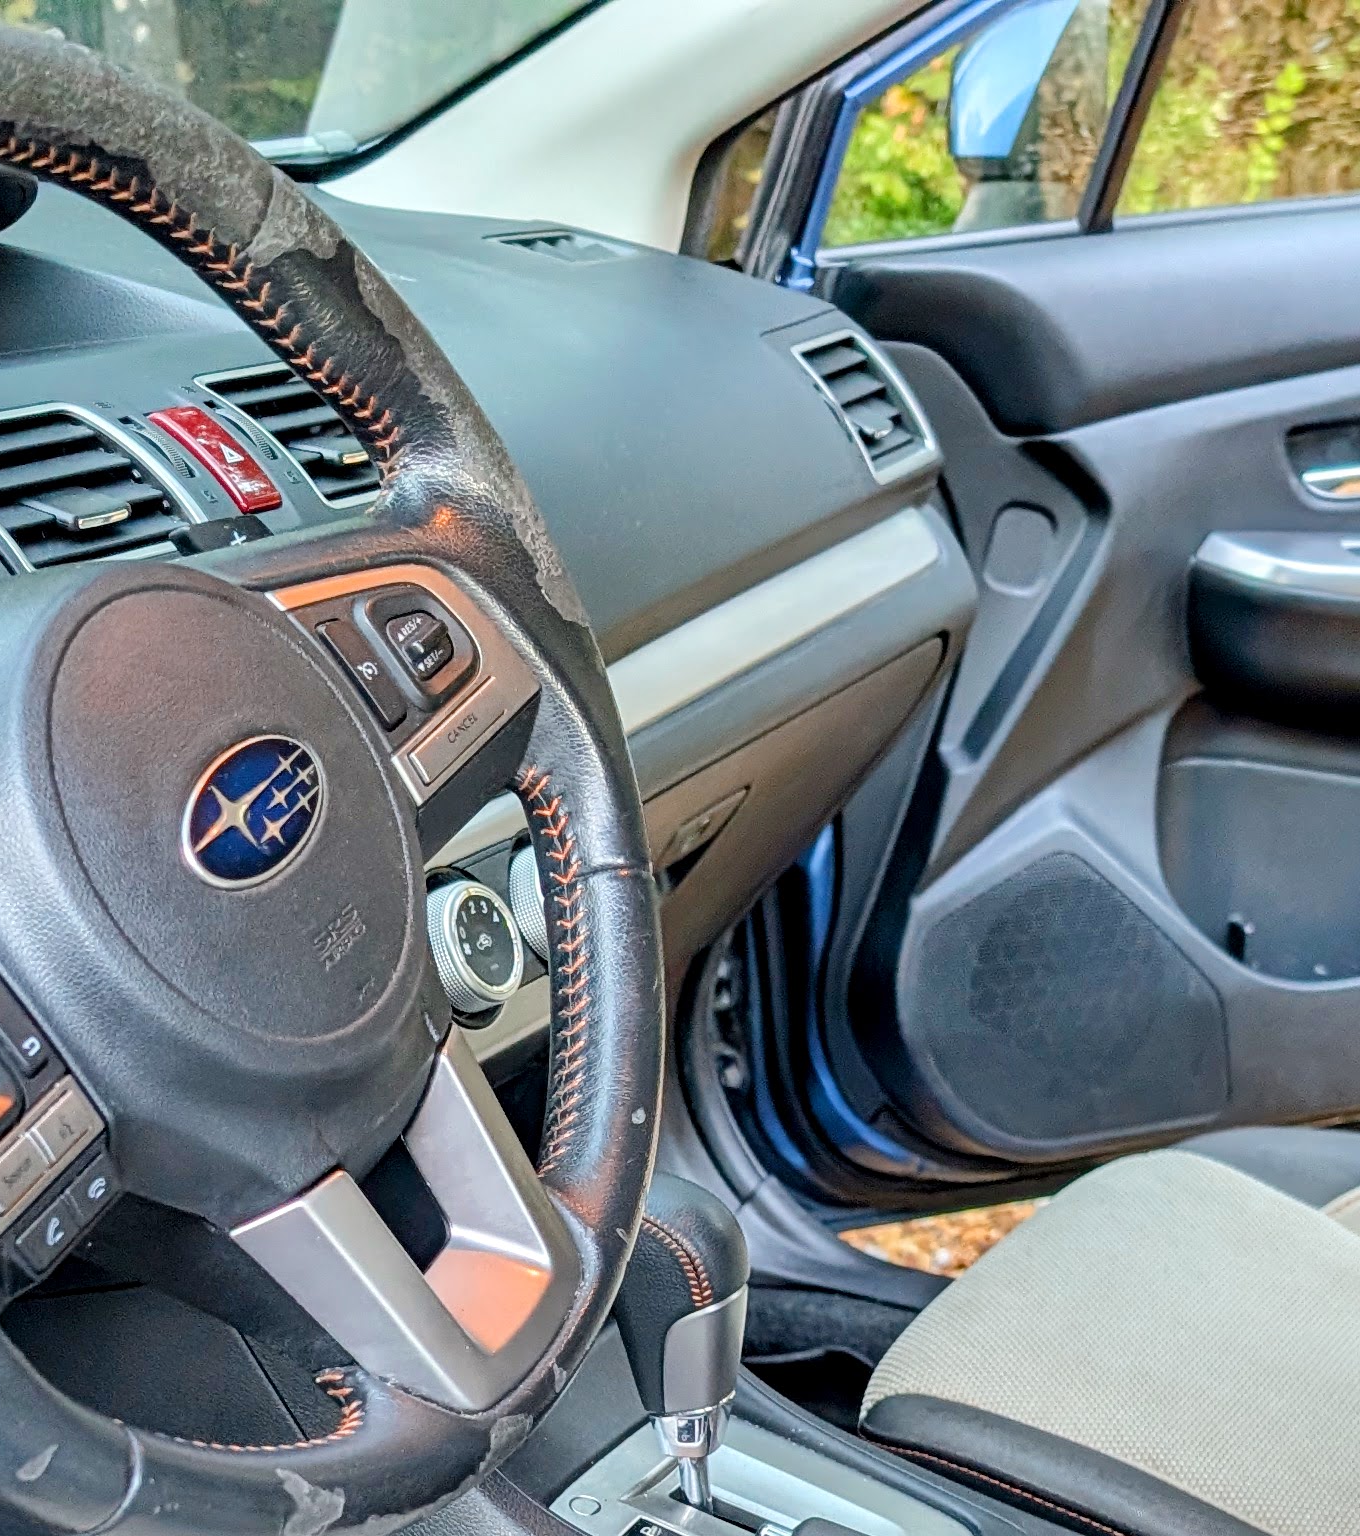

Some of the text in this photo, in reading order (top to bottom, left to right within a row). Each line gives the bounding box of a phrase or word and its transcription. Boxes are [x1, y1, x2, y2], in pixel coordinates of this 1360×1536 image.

[447, 713, 478, 743] CANCEL
[468, 900, 477, 915] 2
[480, 900, 488, 914] 3
